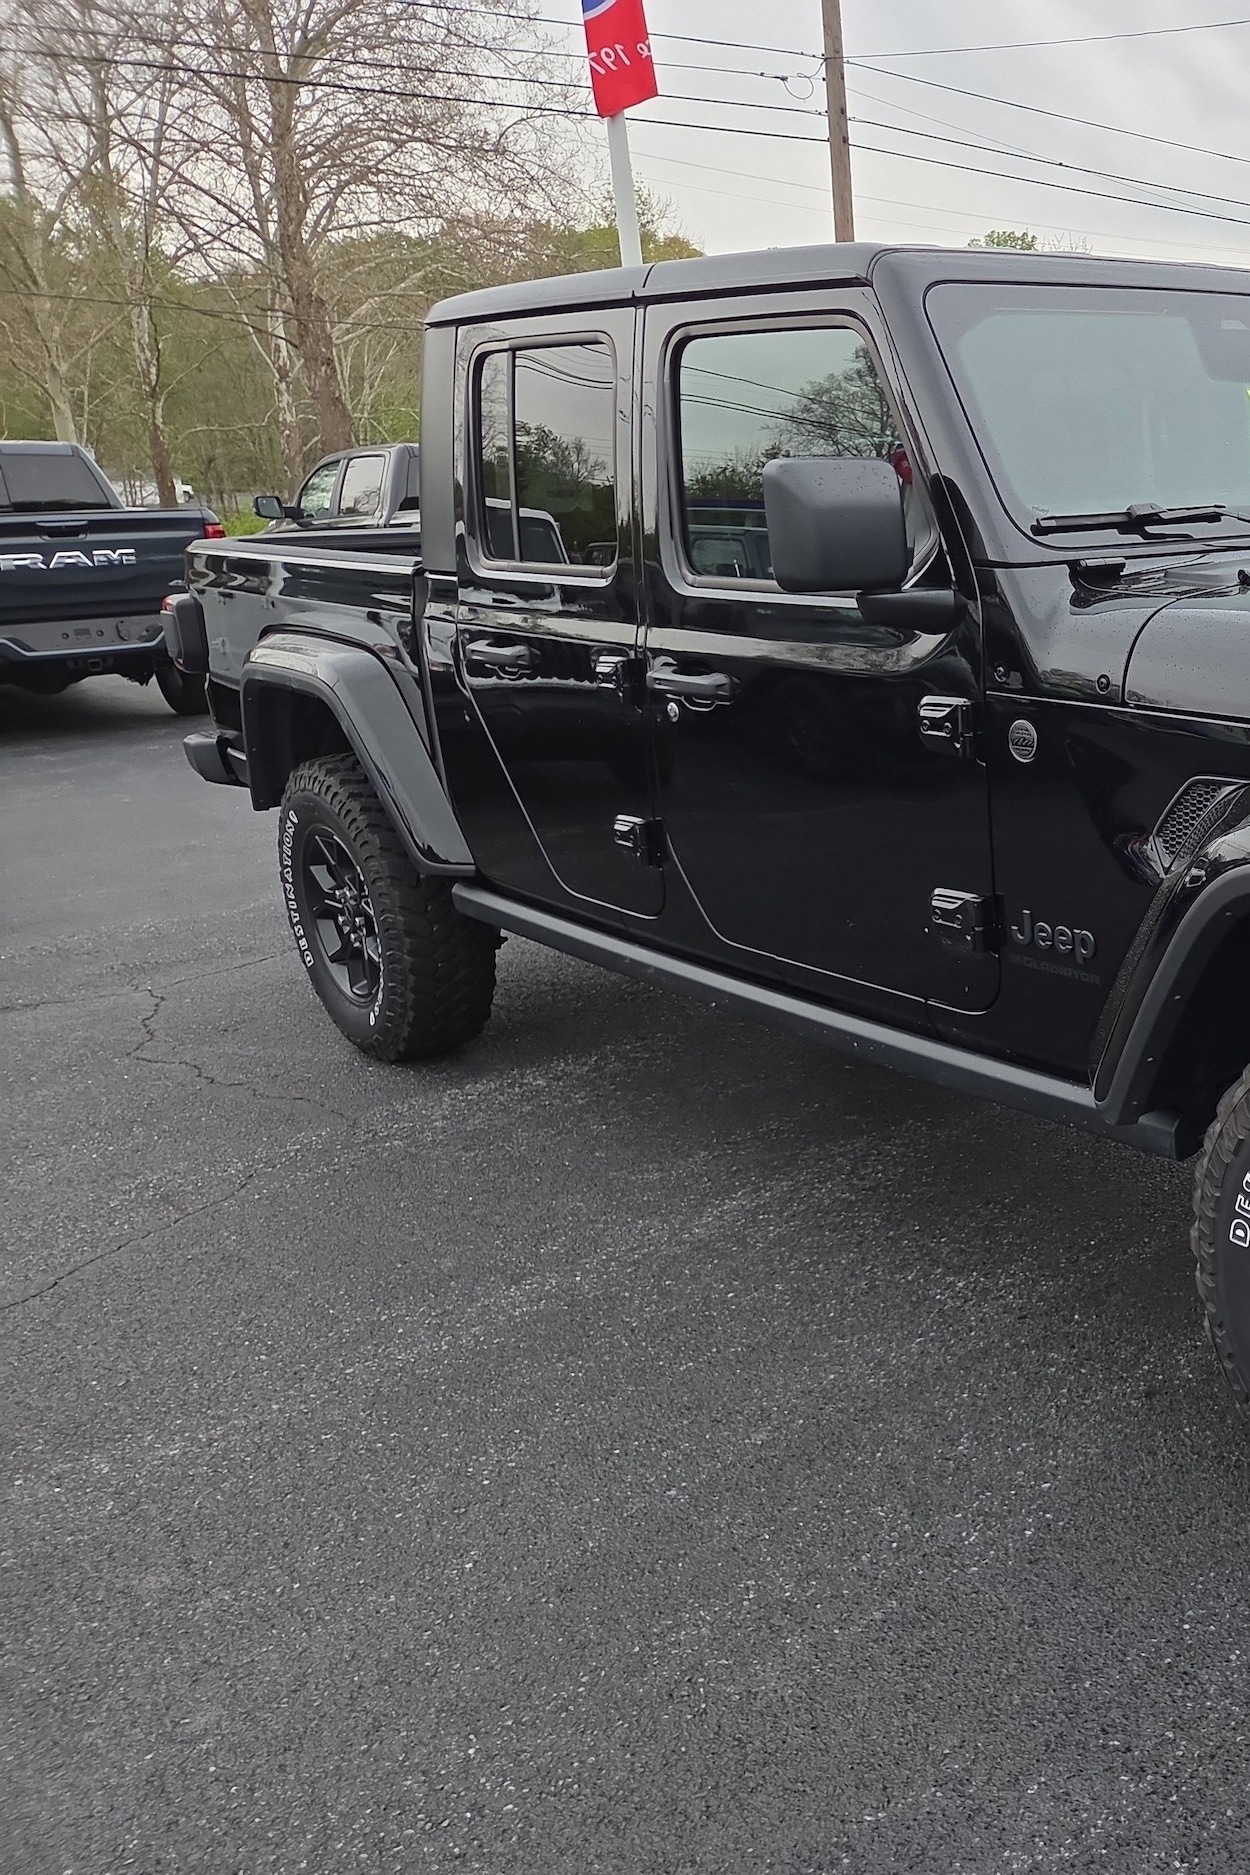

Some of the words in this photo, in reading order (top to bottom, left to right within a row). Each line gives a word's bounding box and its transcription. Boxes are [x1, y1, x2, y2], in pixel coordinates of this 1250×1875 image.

[0, 548, 137, 571] RAM
[283, 821, 314, 967] DESTINATION
[1011, 909, 1096, 964] Jeep
